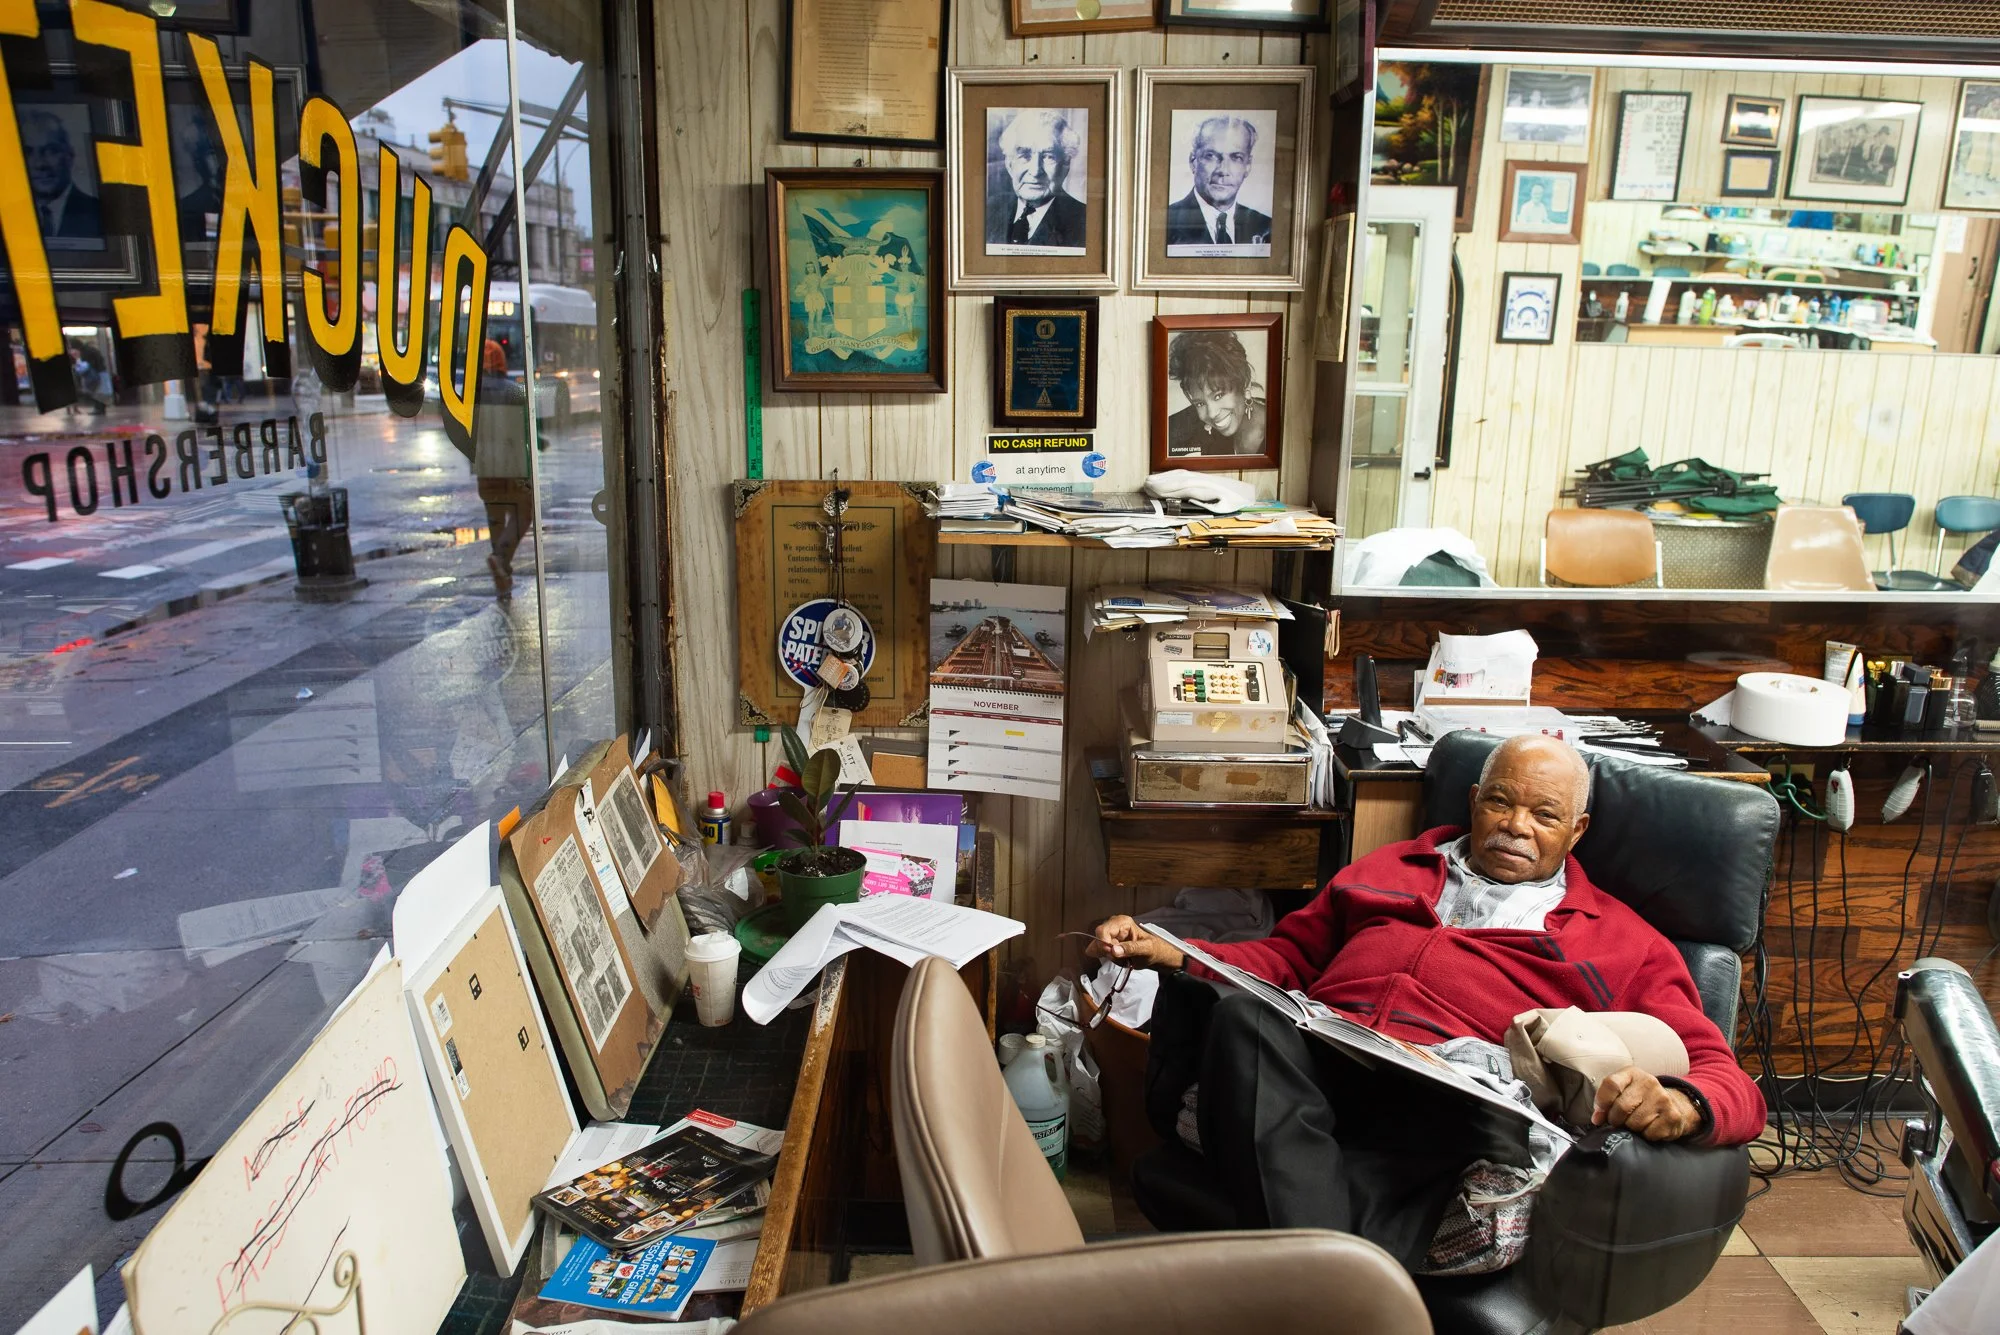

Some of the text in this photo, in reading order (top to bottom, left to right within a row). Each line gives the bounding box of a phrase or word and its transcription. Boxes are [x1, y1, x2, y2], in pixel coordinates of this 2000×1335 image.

[811, 341, 826, 352] OUT
[993, 437, 1088, 449] NO CASH REFUND
[1015, 465, 1066, 476] at anytime
[973, 700, 1019, 711] NOVEMBER
[618, 1280, 640, 1305] GUIDE
